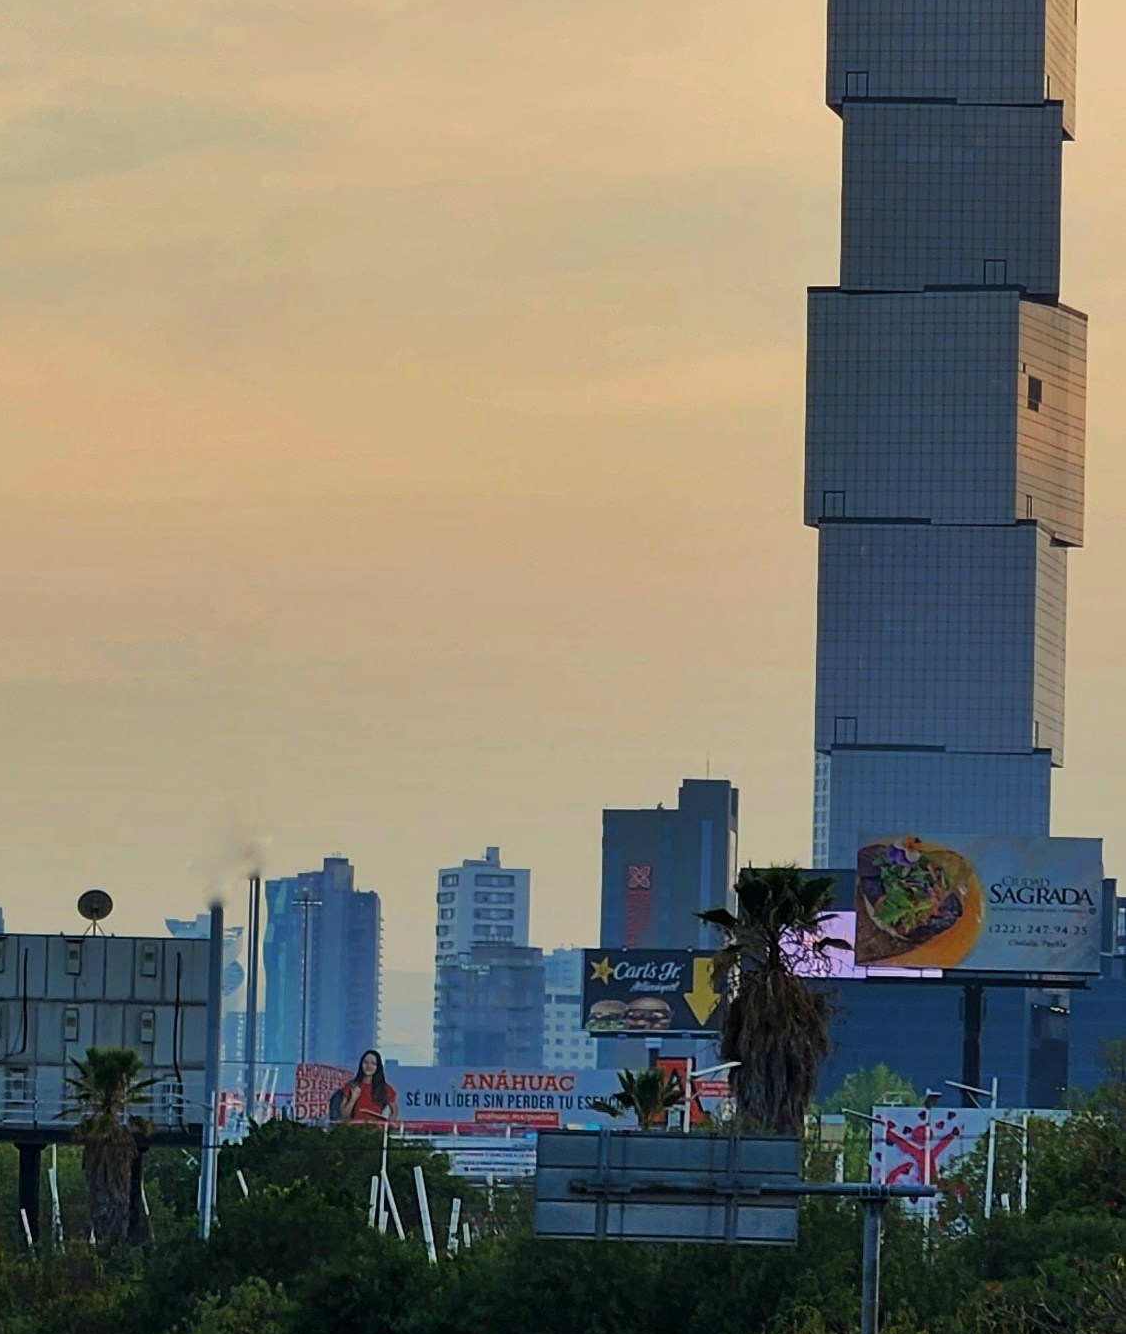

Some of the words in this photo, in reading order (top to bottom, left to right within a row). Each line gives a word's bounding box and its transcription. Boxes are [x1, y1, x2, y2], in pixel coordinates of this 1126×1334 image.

[1001, 875, 1050, 887] CIUDAD
[989, 884, 1094, 906] SAGRADA
[989, 924, 1022, 934] (222)
[613, 961, 658, 981] Carl's
[658, 961, 682, 981] Jr.
[461, 1070, 574, 1092] ANÁHUAC
[406, 1089, 421, 1107] SÉ
[425, 1093, 441, 1107] UN
[483, 1094, 504, 1109] SIN
[507, 1094, 554, 1109] PERDER
[558, 1095, 573, 1110] TU
[295, 1103, 328, 1120] DER
